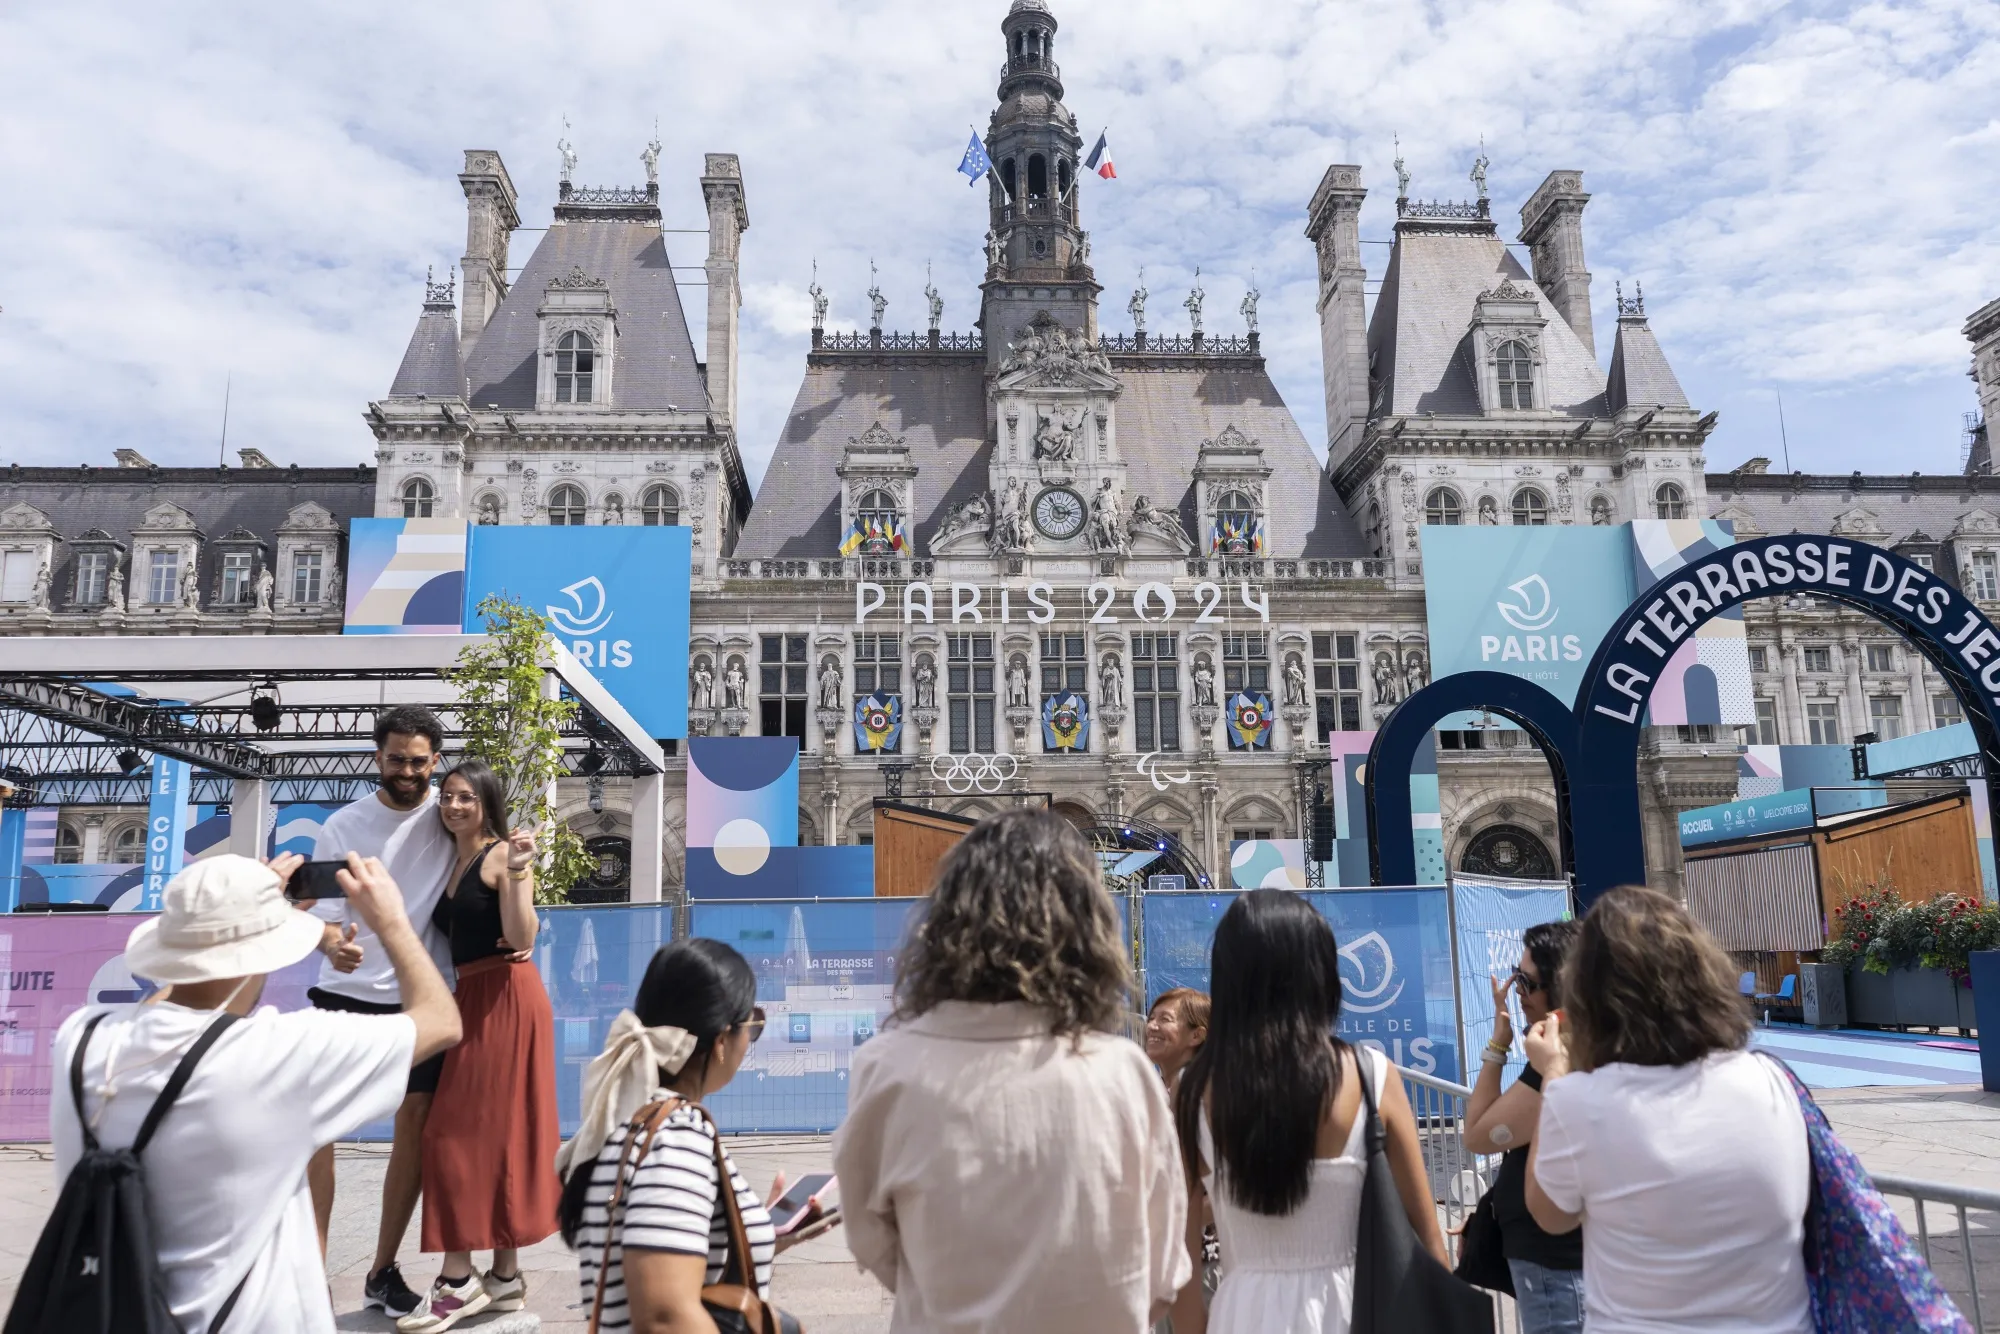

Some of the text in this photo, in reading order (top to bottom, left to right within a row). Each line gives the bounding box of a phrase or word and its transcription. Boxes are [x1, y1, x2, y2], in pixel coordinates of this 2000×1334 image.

[856, 581, 1270, 624] PARIS 2024
[1595, 543, 2000, 724] LA TERRASSE DES JEU
[572, 639, 633, 668] RIS
[1480, 634, 1583, 662] PARIS
[159, 759, 171, 795] LE
[1763, 802, 1809, 819] WELCOME DESK
[1682, 818, 1714, 834] ACCUEIL
[148, 816, 170, 909] COURT
[806, 959, 819, 969] LA
[822, 958, 874, 968] TERRASSE
[1339, 1018, 1413, 1034] LLE DE
